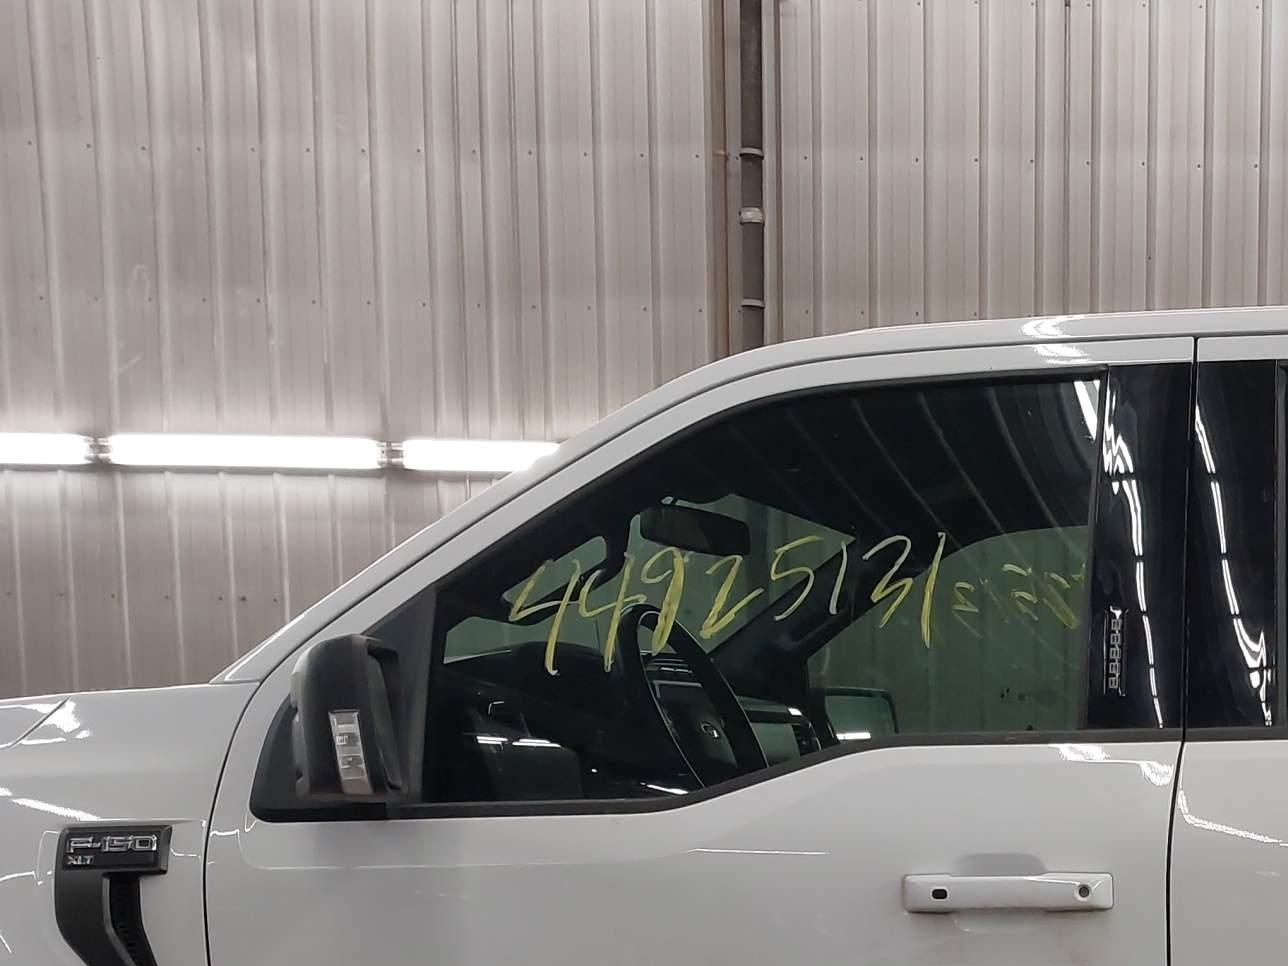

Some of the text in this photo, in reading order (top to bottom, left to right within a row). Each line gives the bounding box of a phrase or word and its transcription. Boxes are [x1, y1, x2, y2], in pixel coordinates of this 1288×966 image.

[509, 531, 947, 676] 44925131
[66, 835, 158, 854] F-150
[66, 855, 94, 866] XLT
